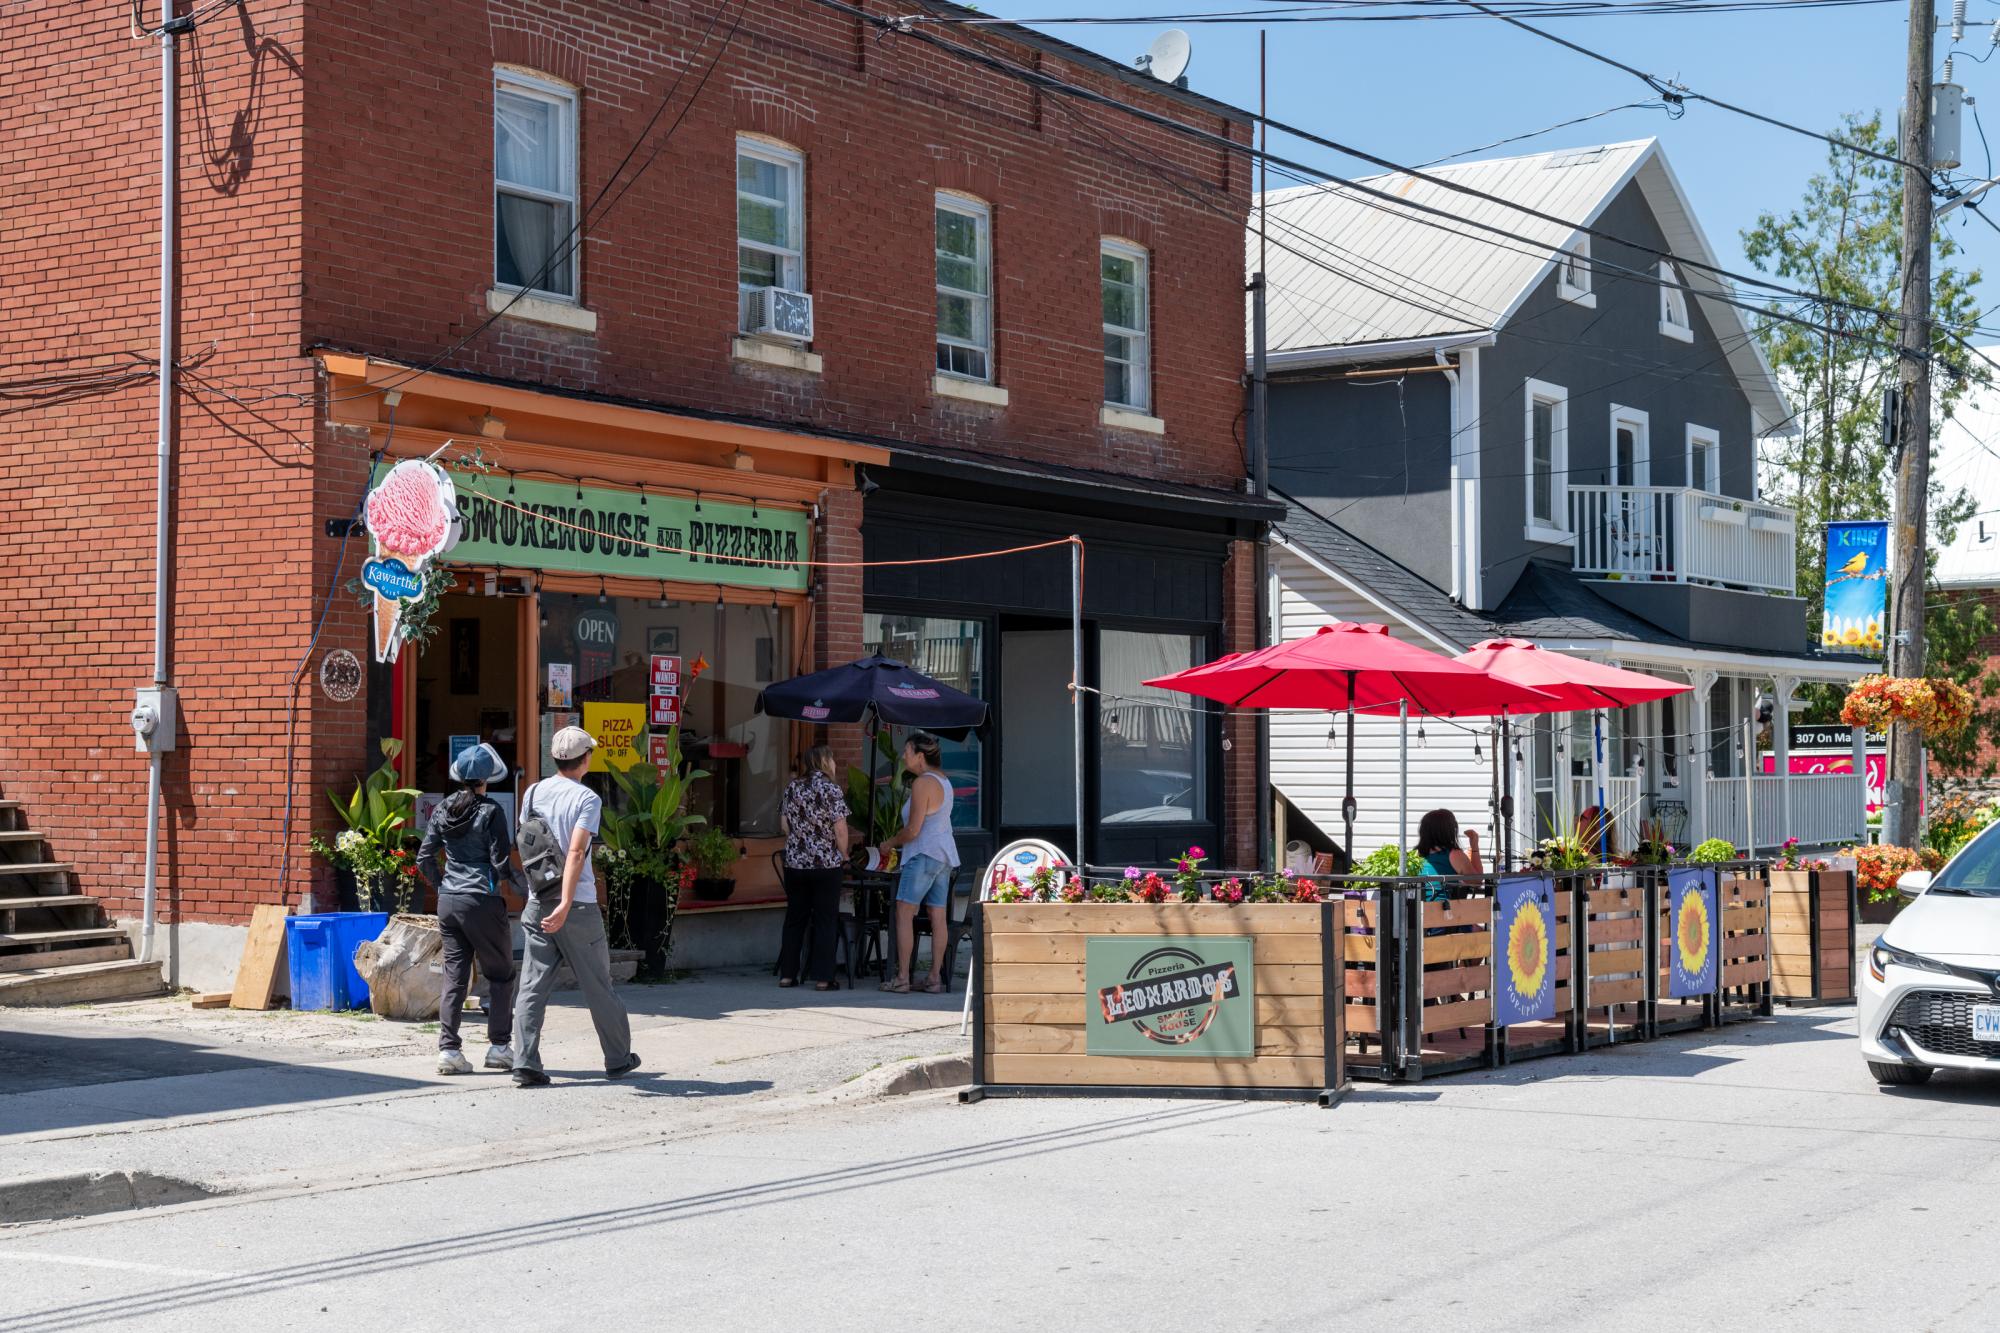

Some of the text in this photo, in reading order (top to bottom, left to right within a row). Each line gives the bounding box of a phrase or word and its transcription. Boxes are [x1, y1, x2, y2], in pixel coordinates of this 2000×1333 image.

[456, 495, 649, 558] SMOKEHOUSE
[689, 521, 800, 571] PIZZERIA
[368, 566, 417, 591] Kawartha
[578, 617, 615, 644] OPEN
[660, 659, 673, 671] HELP
[655, 671, 677, 684] WANTED
[660, 698, 673, 710] HELP
[655, 710, 677, 722] WANTED
[602, 719, 633, 731] PIZZA
[1796, 734, 1814, 744] 307
[1817, 733, 1832, 743] On
[1835, 733, 1853, 743] Ma
[617, 749, 629, 757] OFF
[1148, 962, 1185, 976] Pizzeria
[1105, 970, 1233, 1016] LEONARDOS
[1157, 1008, 1196, 1024] SMOKE
[1159, 1018, 1197, 1033] HOUSE
